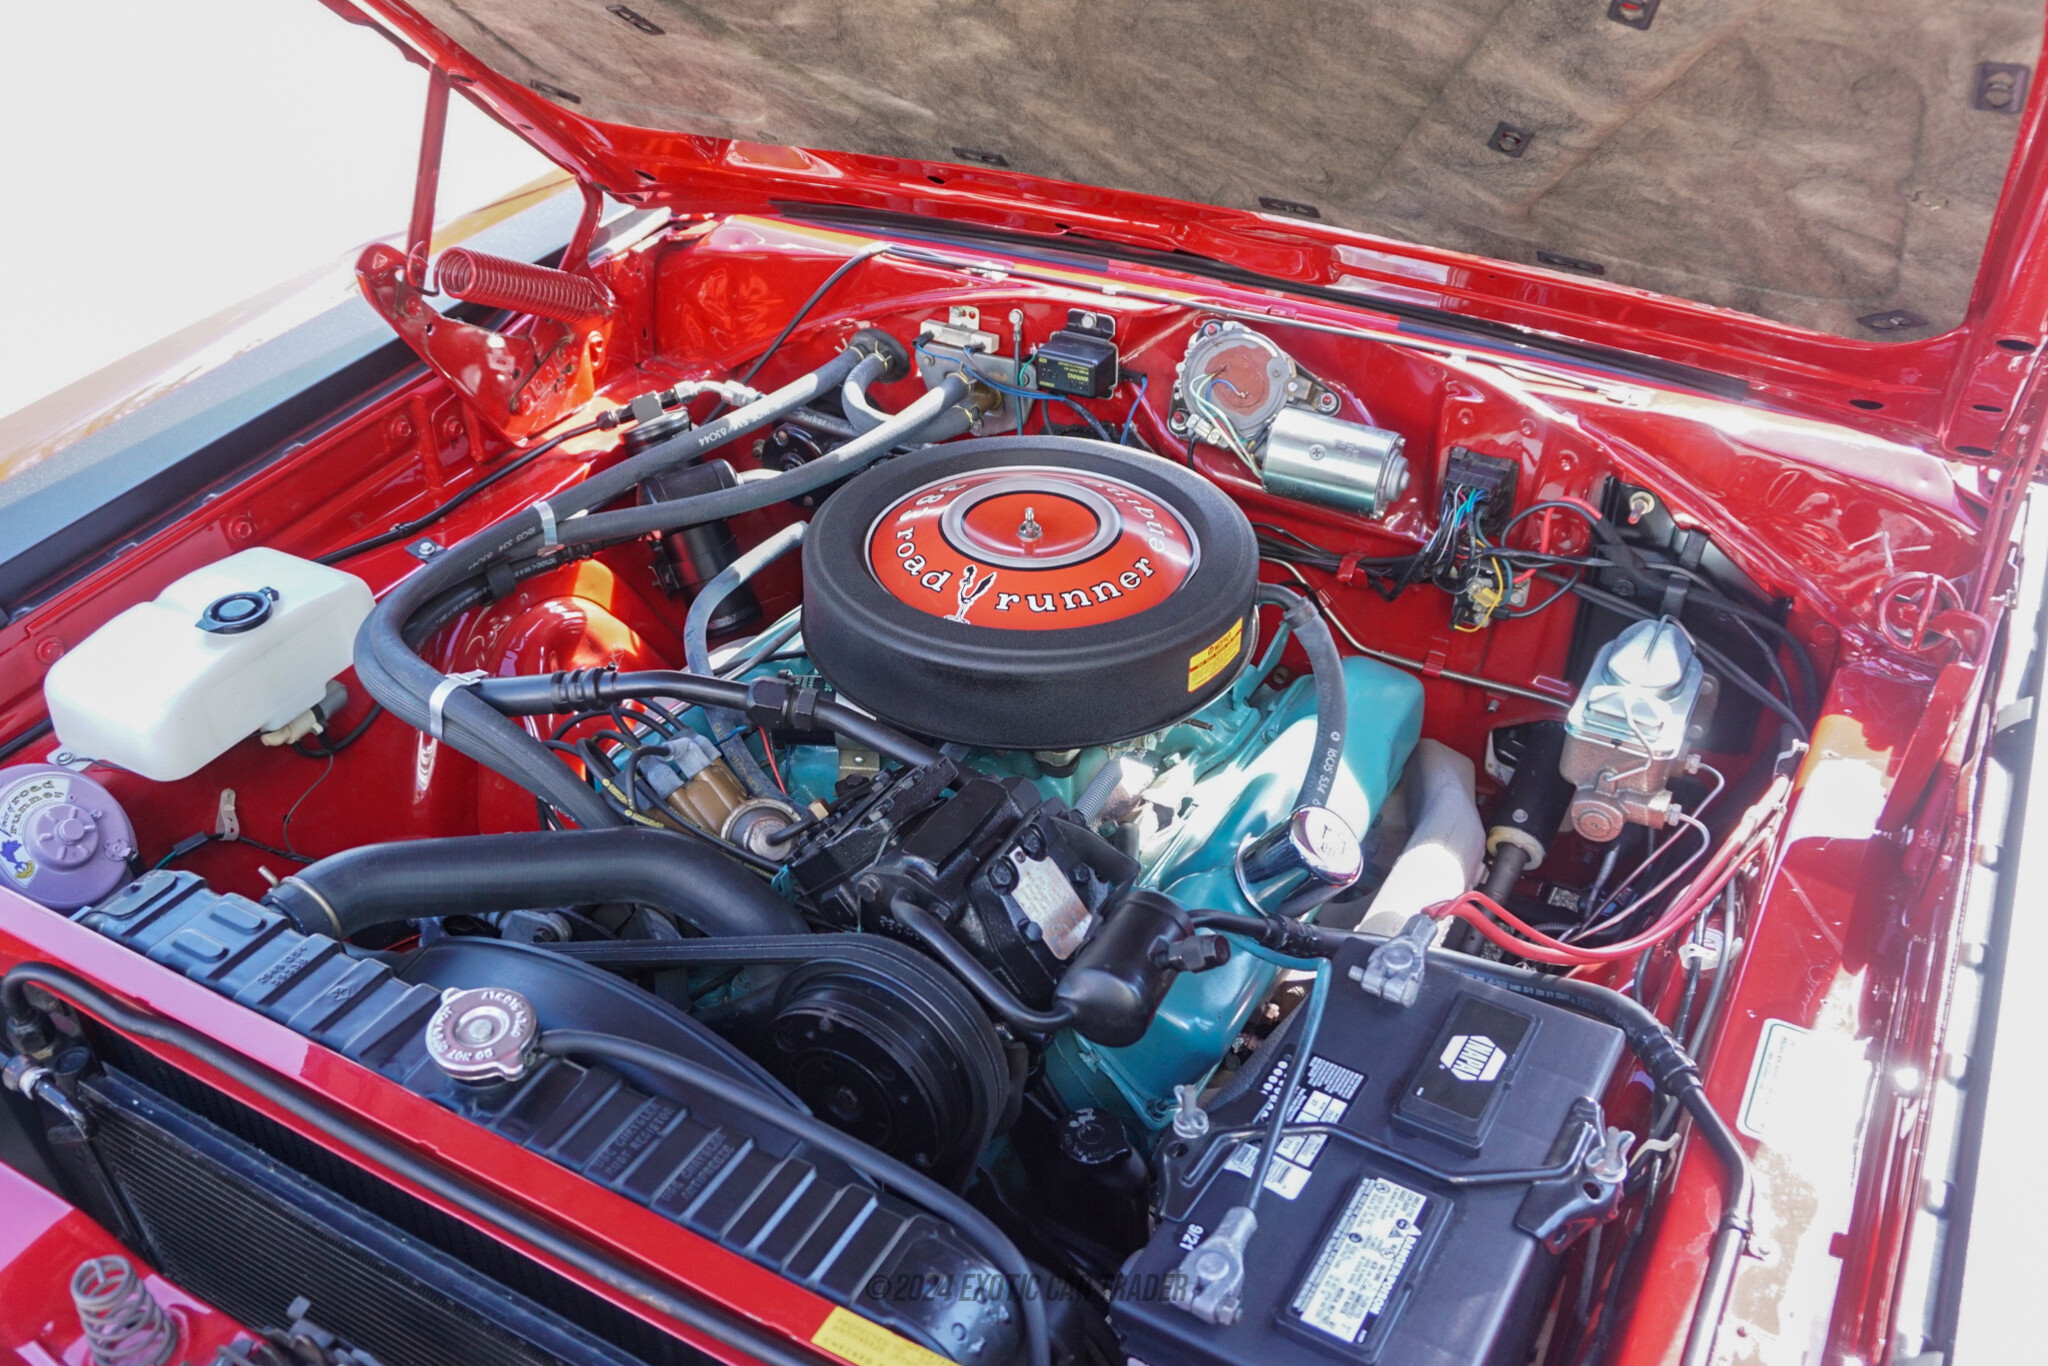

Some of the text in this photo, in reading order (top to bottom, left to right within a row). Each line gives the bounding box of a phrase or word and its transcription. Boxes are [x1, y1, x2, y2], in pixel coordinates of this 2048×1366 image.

[894, 525, 1155, 613] road runner
[1323, 747, 1339, 774] 1605
[11, 780, 55, 806] road
[1315, 774, 1330, 795] 534
[10, 791, 65, 836] runner
[1178, 1222, 1205, 1251] 9/21
